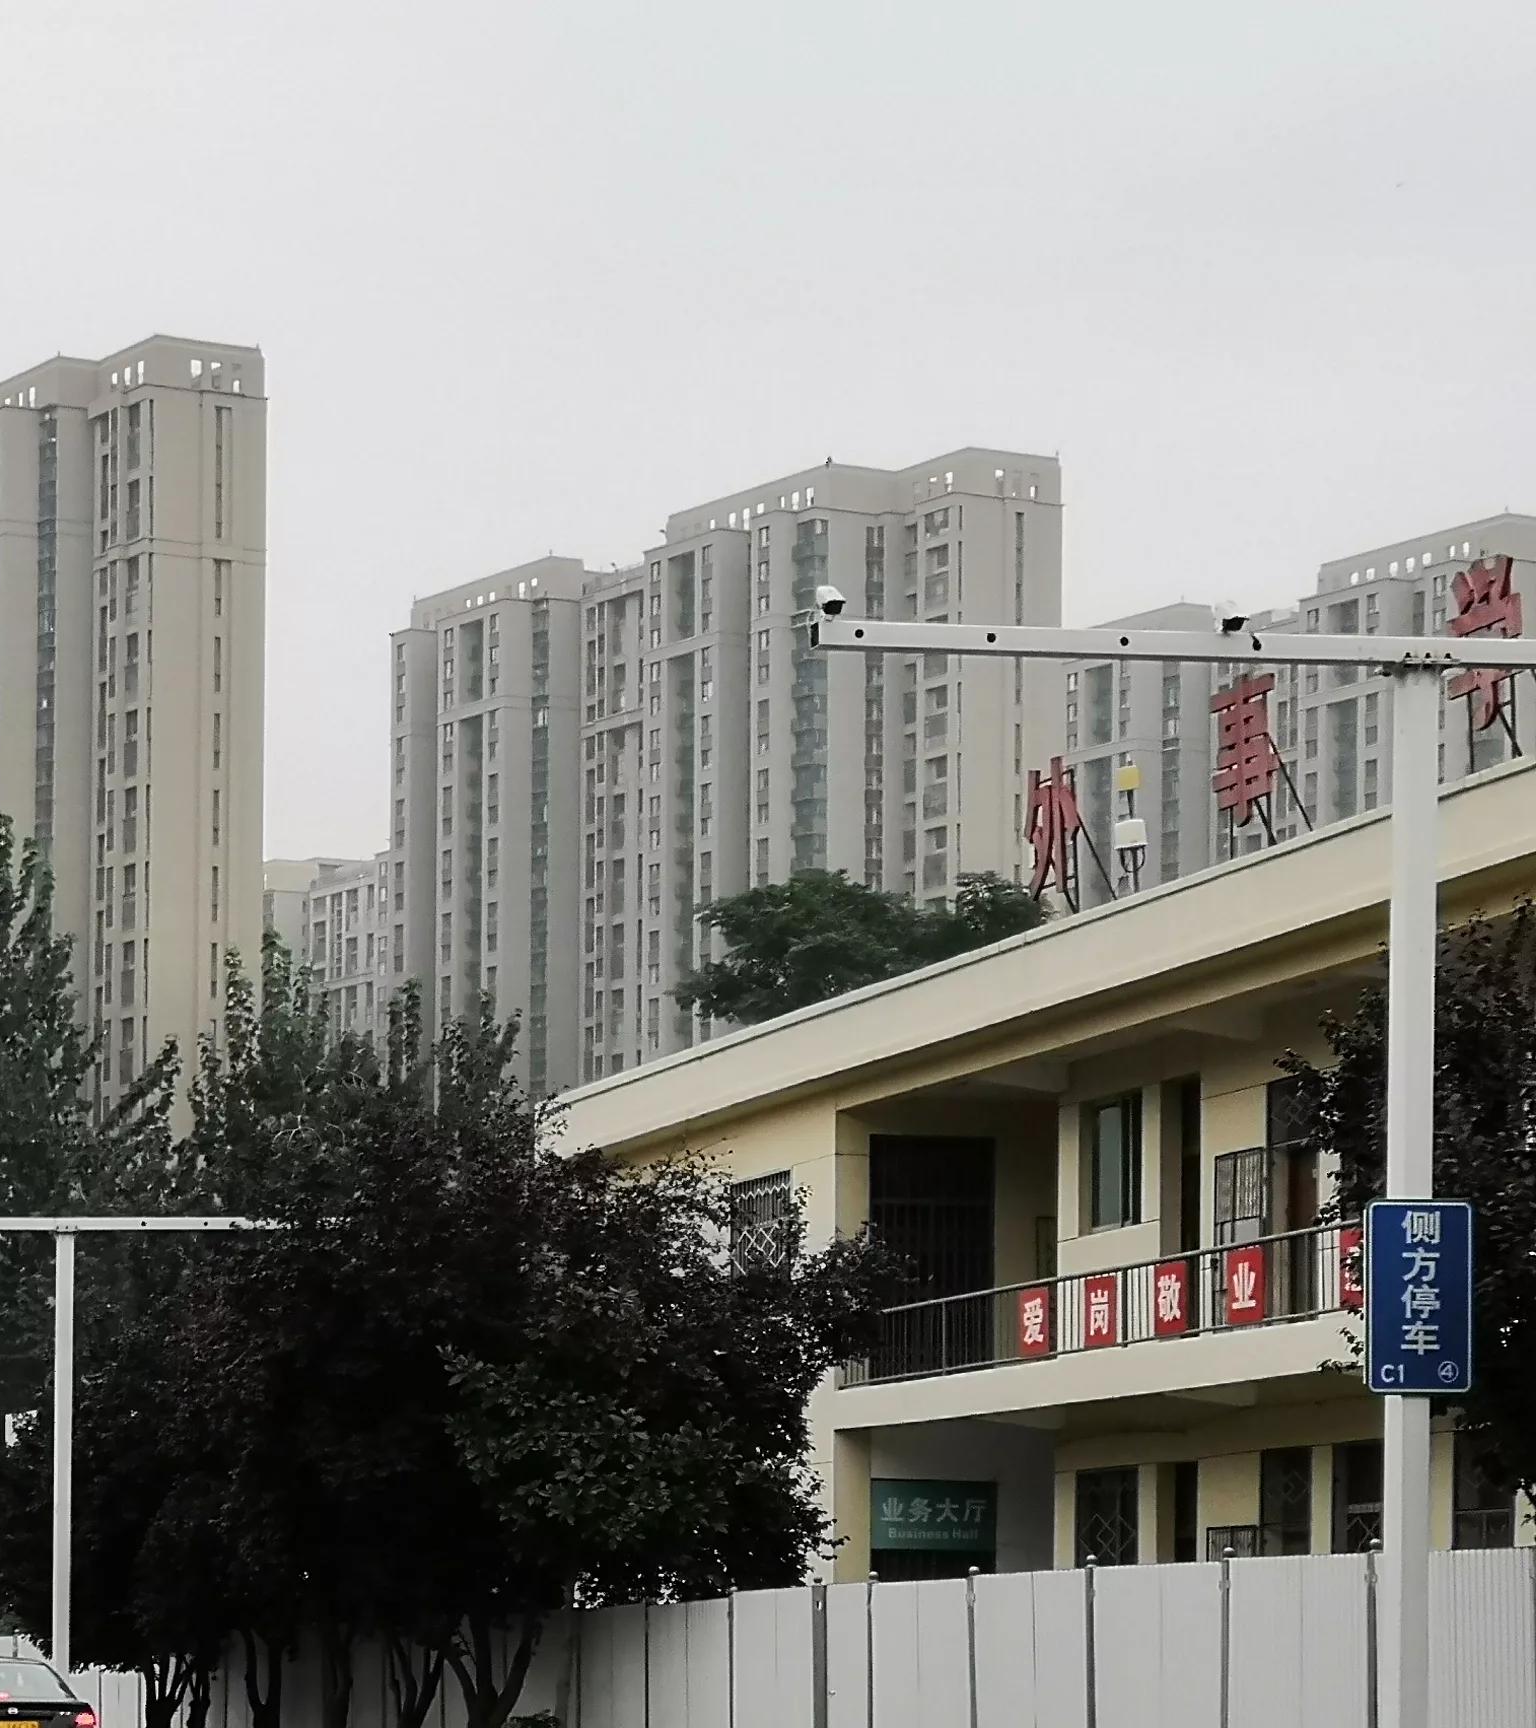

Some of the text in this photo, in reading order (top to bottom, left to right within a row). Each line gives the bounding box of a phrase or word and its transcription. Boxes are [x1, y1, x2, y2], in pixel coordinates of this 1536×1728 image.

[1401, 1210, 1440, 1355] 侧方停车
[1381, 1364, 1405, 1384] C1
[880, 1497, 987, 1523] 业务大厅
[889, 1527, 979, 1540] Business Hall
